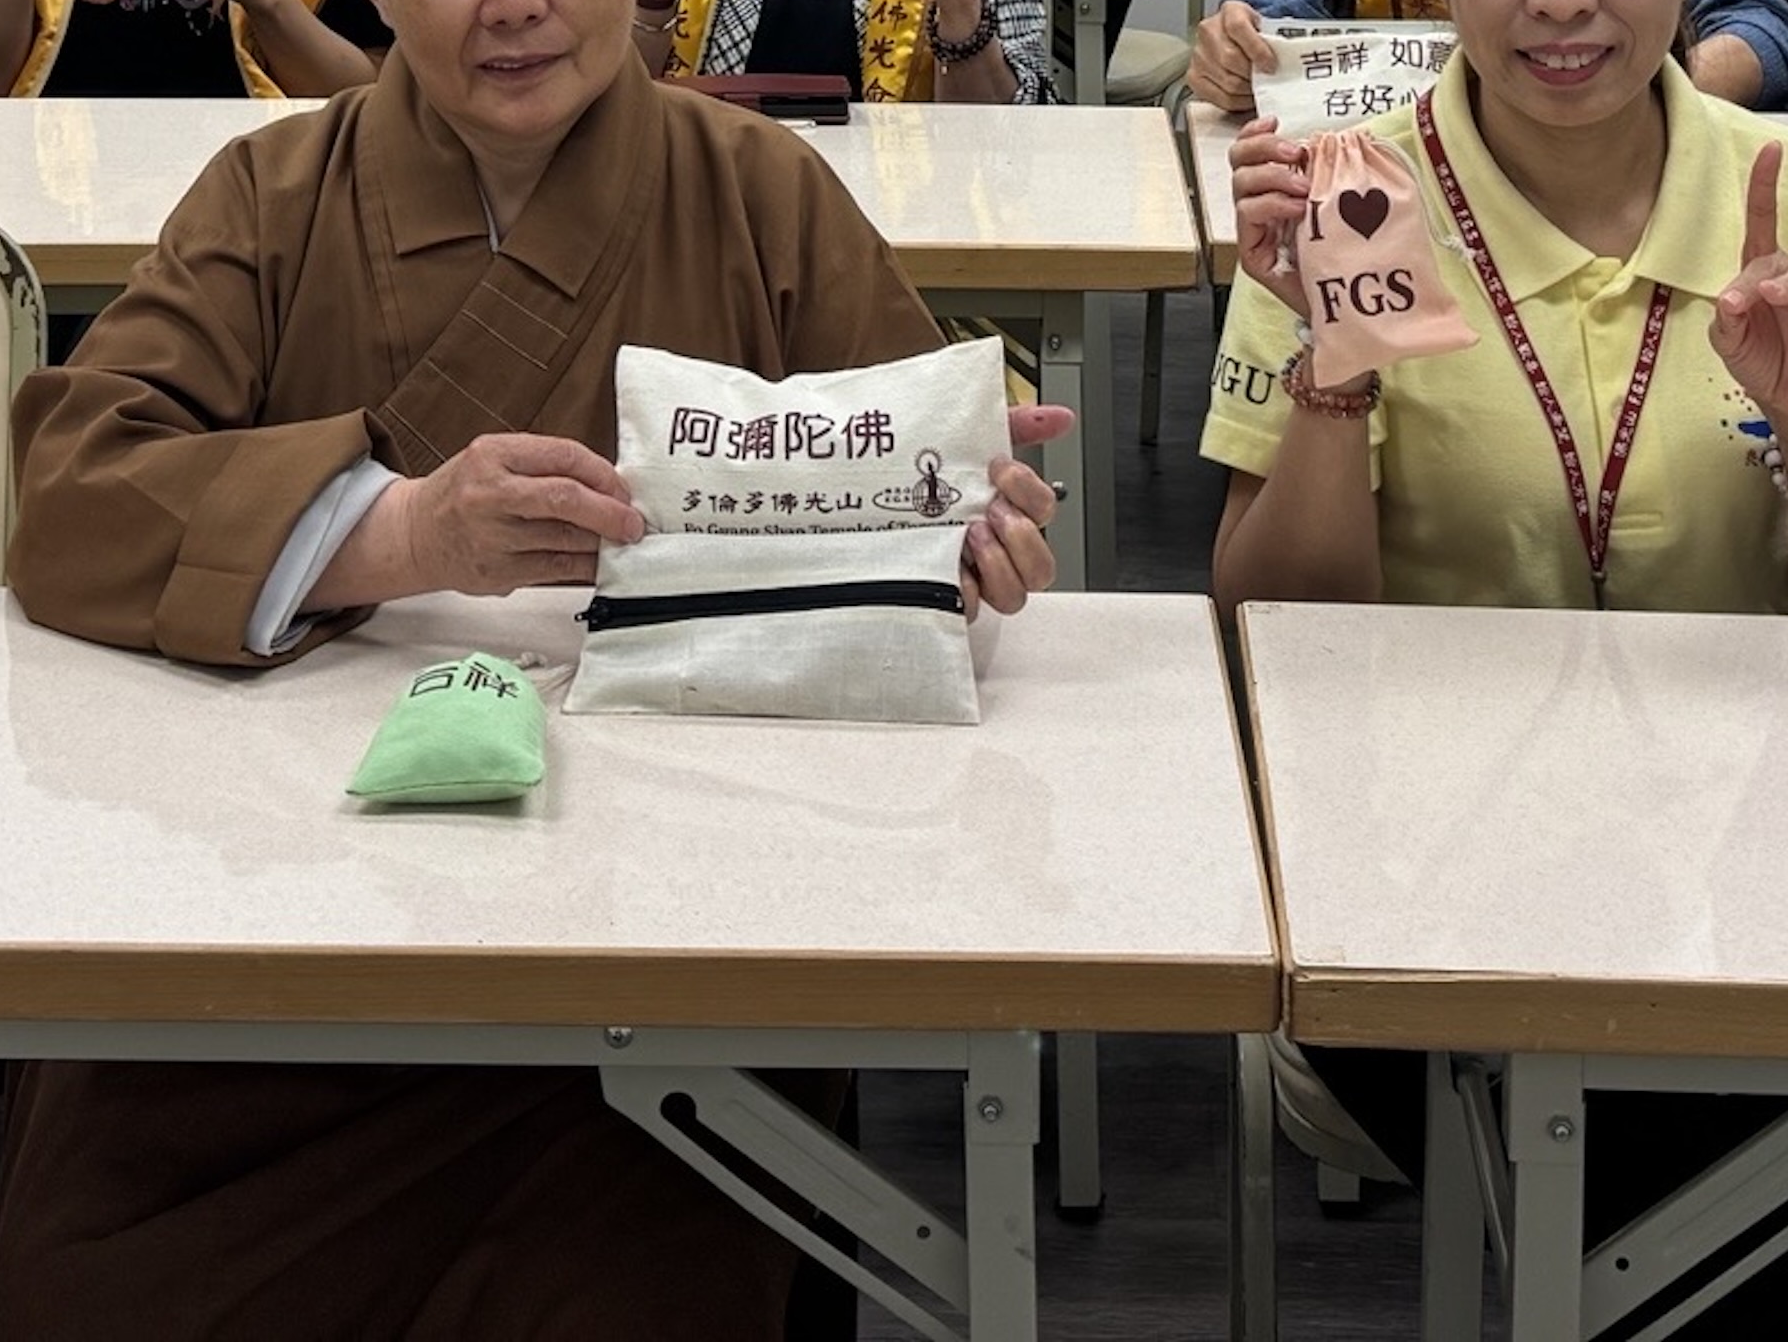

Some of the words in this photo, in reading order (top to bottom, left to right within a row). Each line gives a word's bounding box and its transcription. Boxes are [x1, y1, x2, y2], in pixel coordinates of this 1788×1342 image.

[1300, 41, 1370, 80] 吉祥
[1309, 200, 1325, 242] I
[1316, 269, 1416, 324] FGS
[668, 407, 897, 462] 阿彌陀佛
[681, 489, 862, 515] 多倫多佛光山
